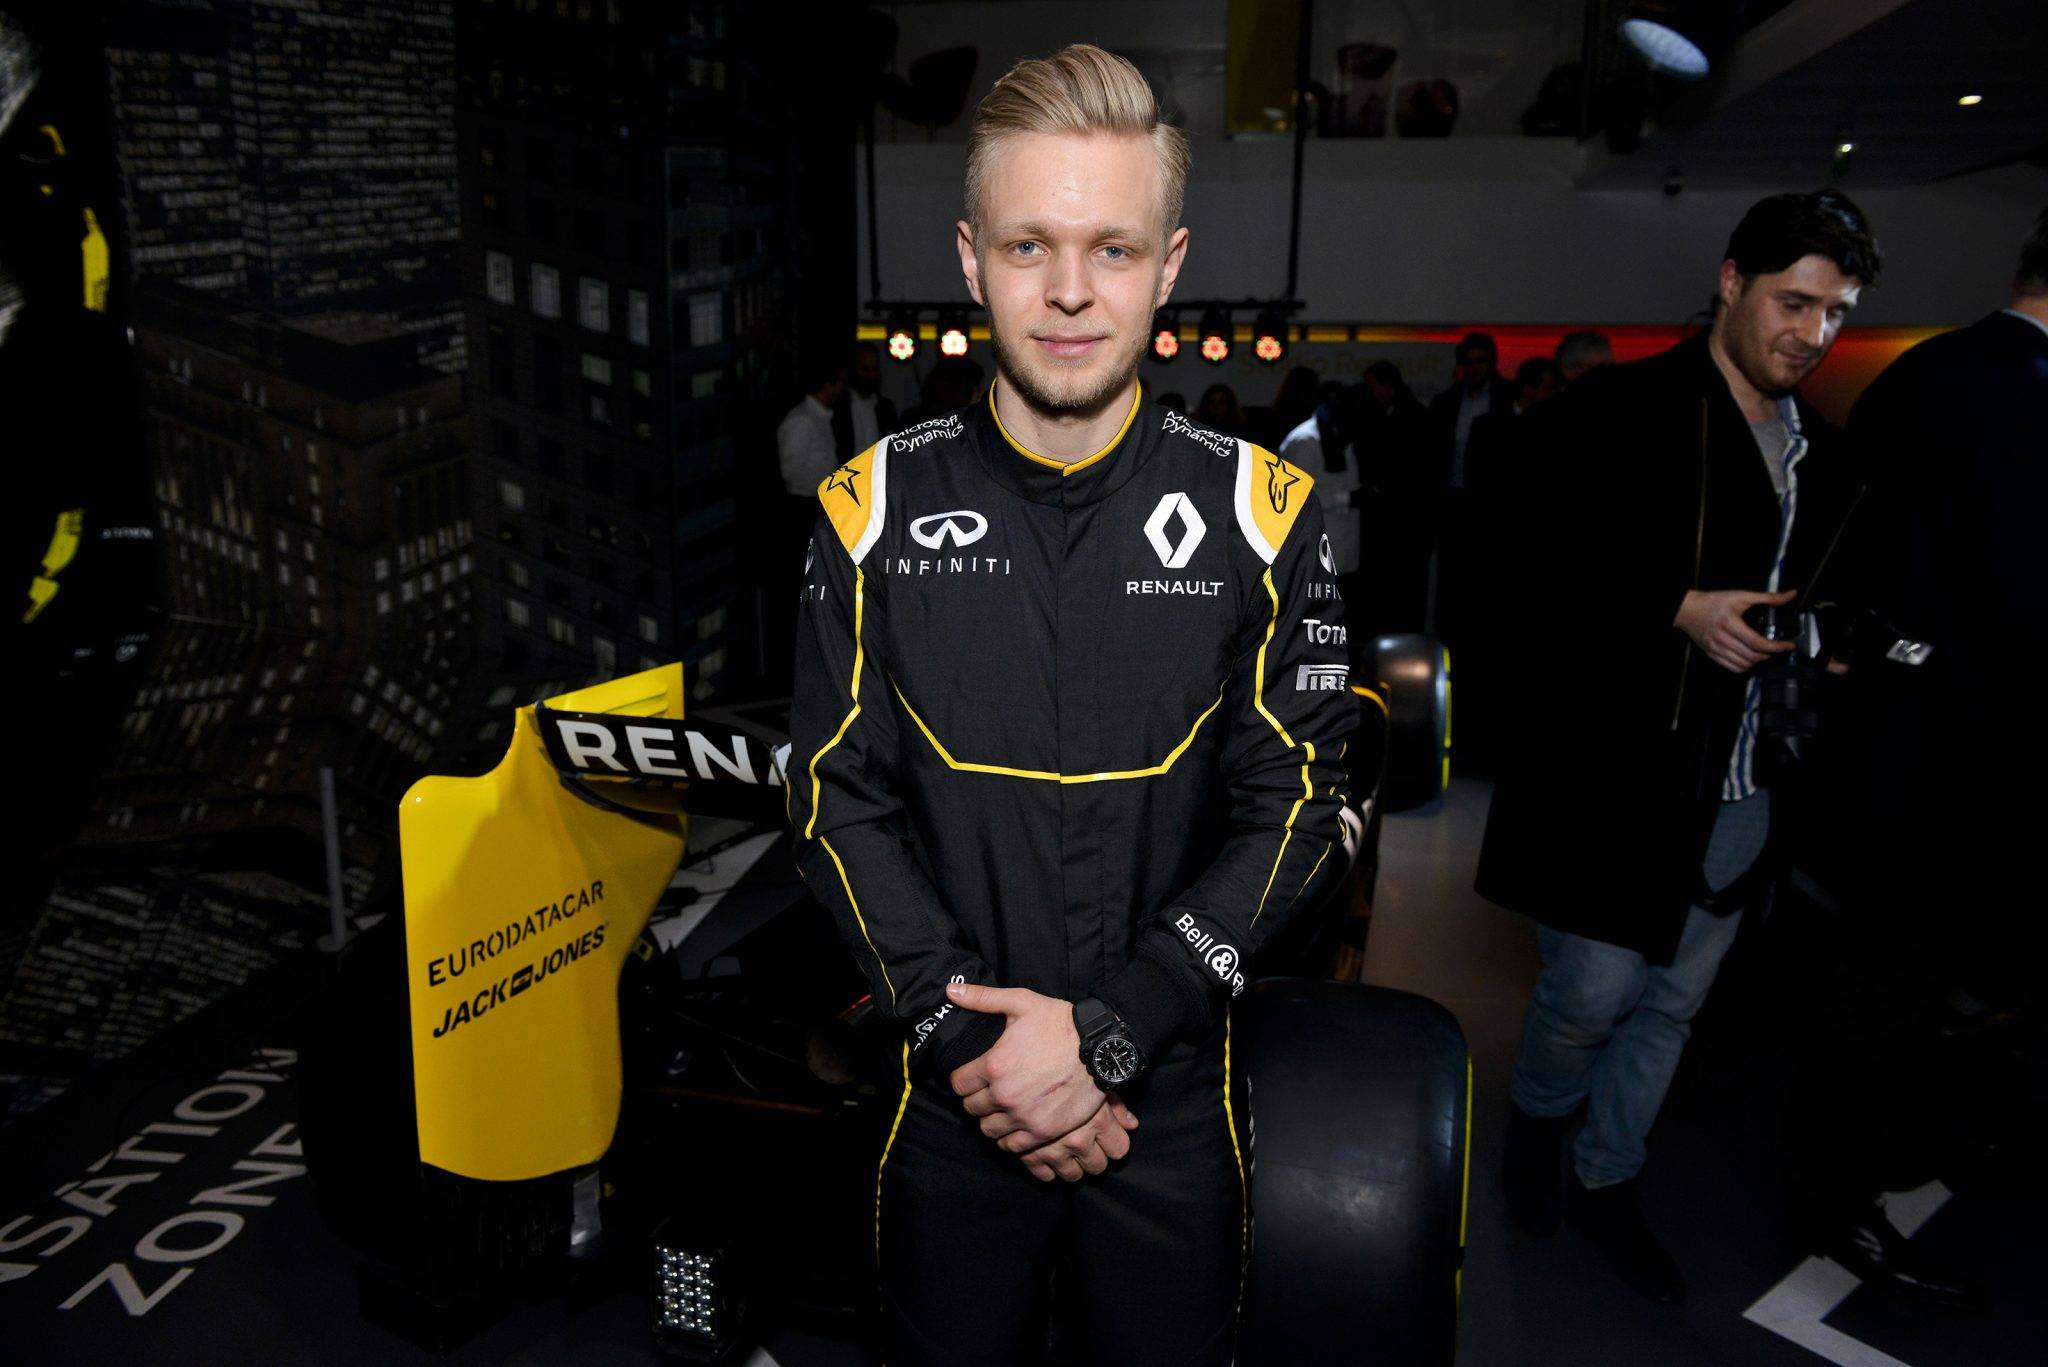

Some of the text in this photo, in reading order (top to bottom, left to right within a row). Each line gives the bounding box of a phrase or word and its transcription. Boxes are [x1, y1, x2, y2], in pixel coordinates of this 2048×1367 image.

[889, 414, 958, 441] Microsoft
[893, 423, 964, 452] Dynamics
[1162, 418, 1231, 457] Dynamics
[1167, 411, 1236, 447] Miosoft
[885, 557, 1010, 575] INFINITI
[1126, 580, 1224, 597] RENAULT
[1307, 582, 1342, 600] INFI
[428, 880, 604, 988] EURODATACAR
[1175, 913, 1214, 953] Bell
[1207, 946, 1237, 979] &
[433, 924, 606, 1038] JACK JONES
[0, 1047, 299, 1281] SATION
